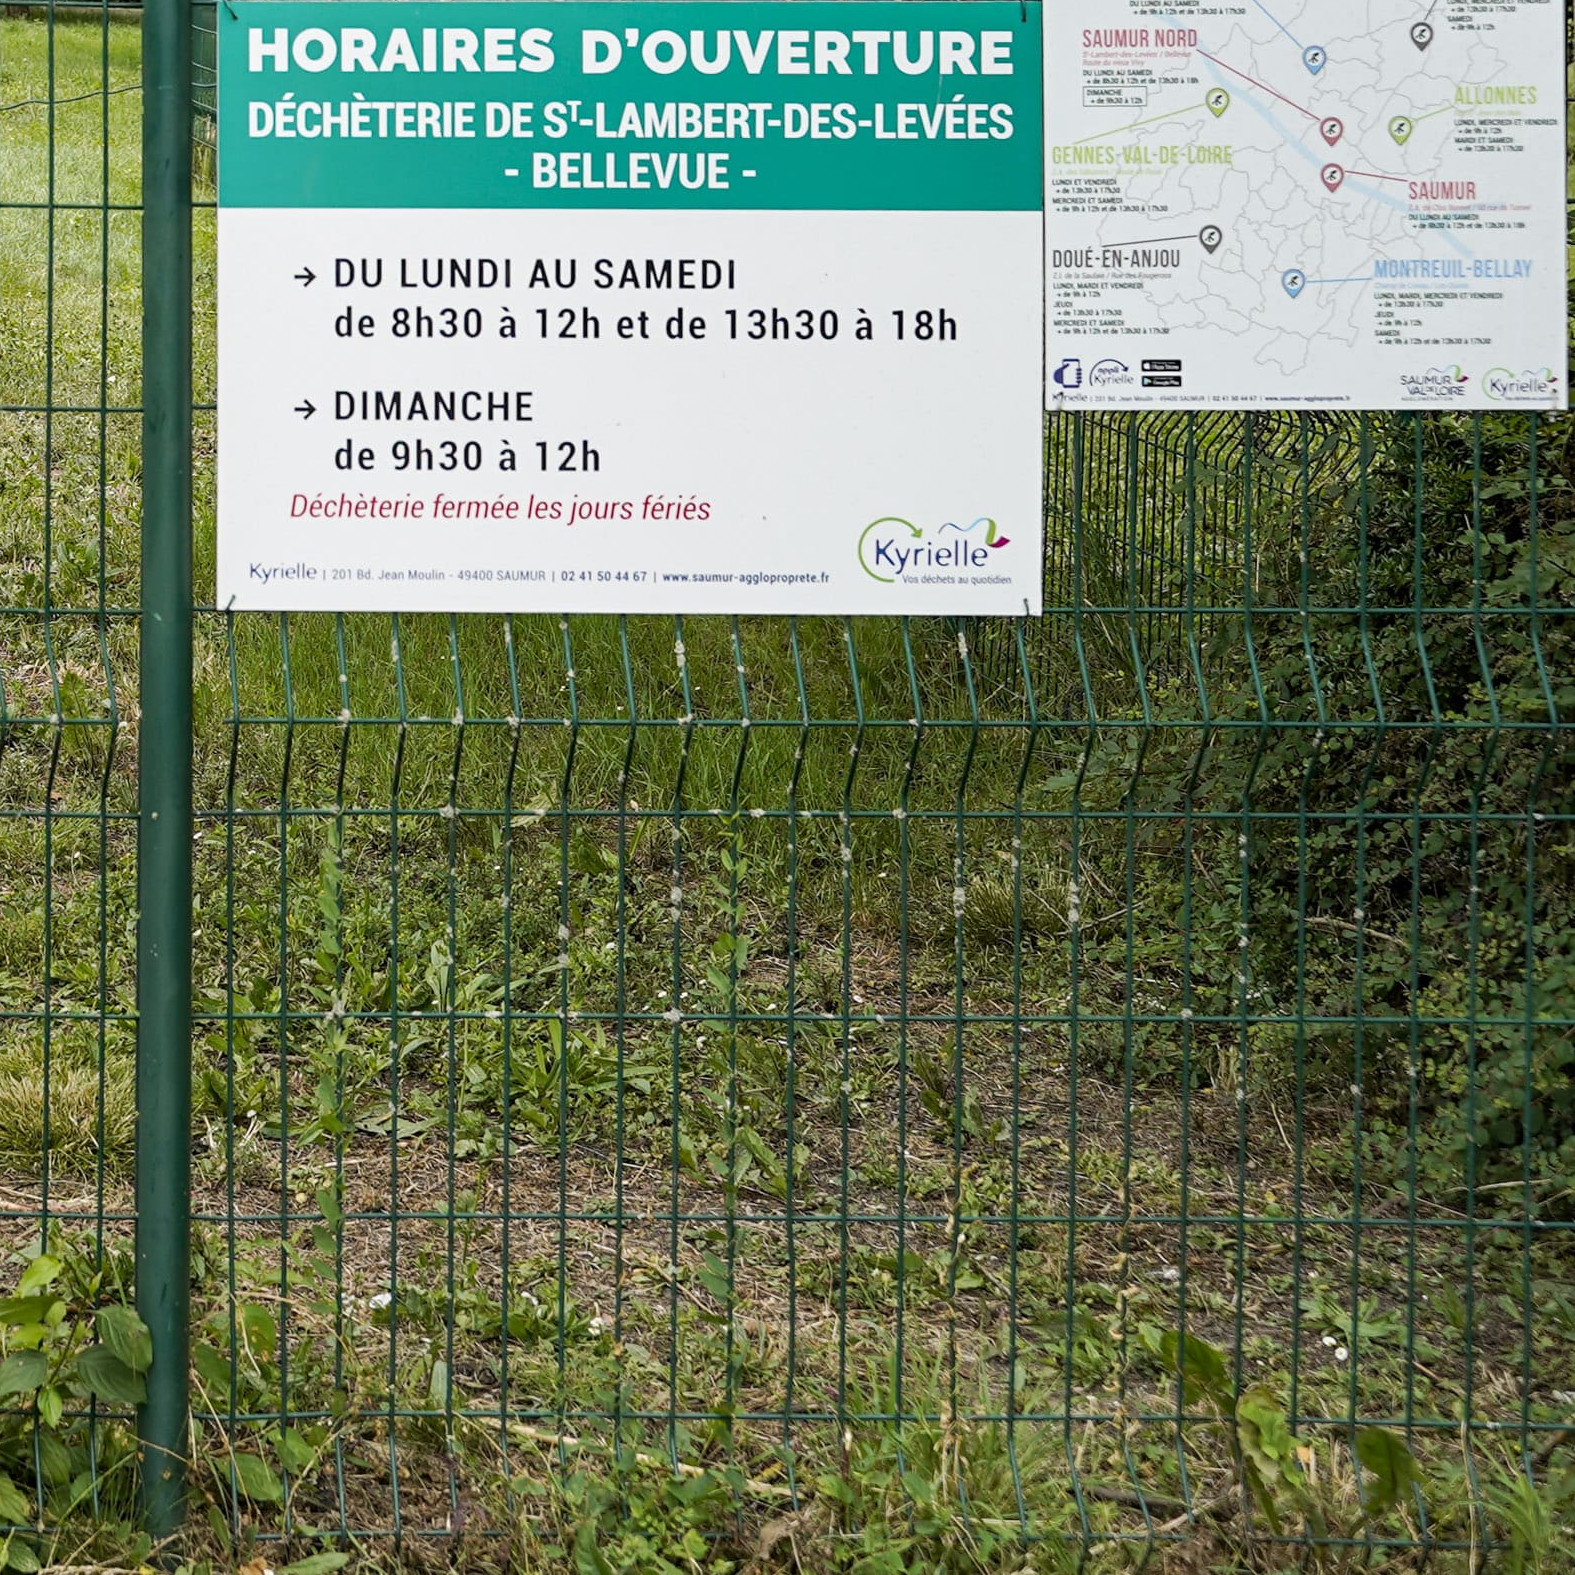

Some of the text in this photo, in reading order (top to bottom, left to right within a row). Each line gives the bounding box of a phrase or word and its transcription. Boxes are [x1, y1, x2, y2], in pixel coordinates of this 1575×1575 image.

[1083, 29, 1197, 48] SAUMUR NORD
[248, 27, 1013, 74] HORAIRES D'OUVERTURE
[1454, 86, 1537, 104] ALLONNES
[249, 92, 475, 139] DÉCHÈTERIE
[487, 101, 533, 139] DE
[1052, 146, 1232, 164] GENNES-VAL-DE-LOIRE
[534, 152, 730, 189] BELLEVUE
[1408, 182, 1476, 200] SAUMUR
[1053, 246, 1180, 267] DOUÉ-EN-ANJOU
[335, 258, 734, 289] DU LUNDI AU SAMEDI
[1374, 260, 1531, 278] MONTREUIL-BELLAY
[335, 305, 956, 340] de 8h30 à 12h et de 13h30 à 18h
[1094, 374, 1133, 386] Kyrielle
[1098, 366, 1119, 375] appli
[1401, 376, 1450, 385] SAUMUR
[1407, 386, 1426, 396] VAL
[1436, 386, 1465, 396] LOIRE
[1490, 379, 1547, 396] Kyrielle
[335, 390, 532, 421] DIMANCHE
[335, 438, 599, 471] de 9h30 à 12h
[290, 494, 712, 525] Déchèterie fermée les jours fériés
[875, 539, 988, 575] Kyrielle
[250, 563, 829, 584] Kyrielle 201 Bd. Jean Moulin 49400 SAUMUR 02 41 50 44 67 www.saumur-aggloproprete.fr
[921, 575, 955, 584] déchets
[971, 576, 1011, 585] quotidien
